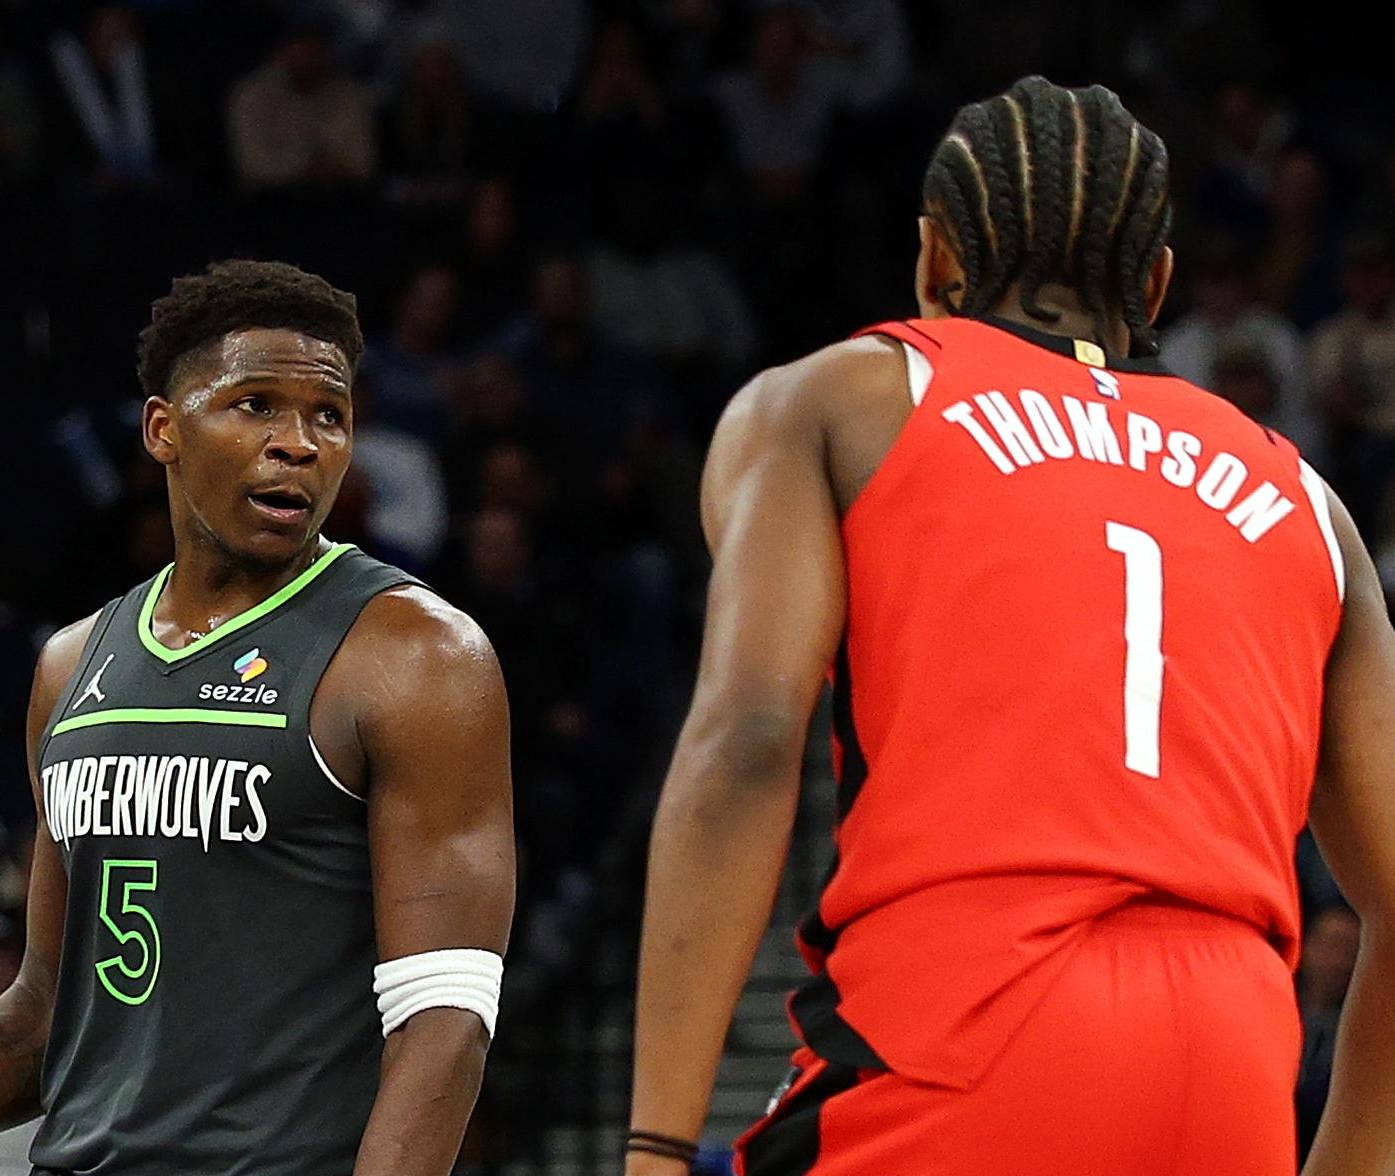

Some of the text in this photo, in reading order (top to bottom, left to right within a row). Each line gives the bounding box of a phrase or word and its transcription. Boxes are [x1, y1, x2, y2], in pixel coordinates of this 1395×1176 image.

[942, 389, 1296, 543] THOMPSON
[198, 683, 278, 705] sezzle
[1106, 520, 1164, 779] 1
[42, 756, 272, 852] TIMBERWOLVES
[96, 859, 162, 1006] 5
